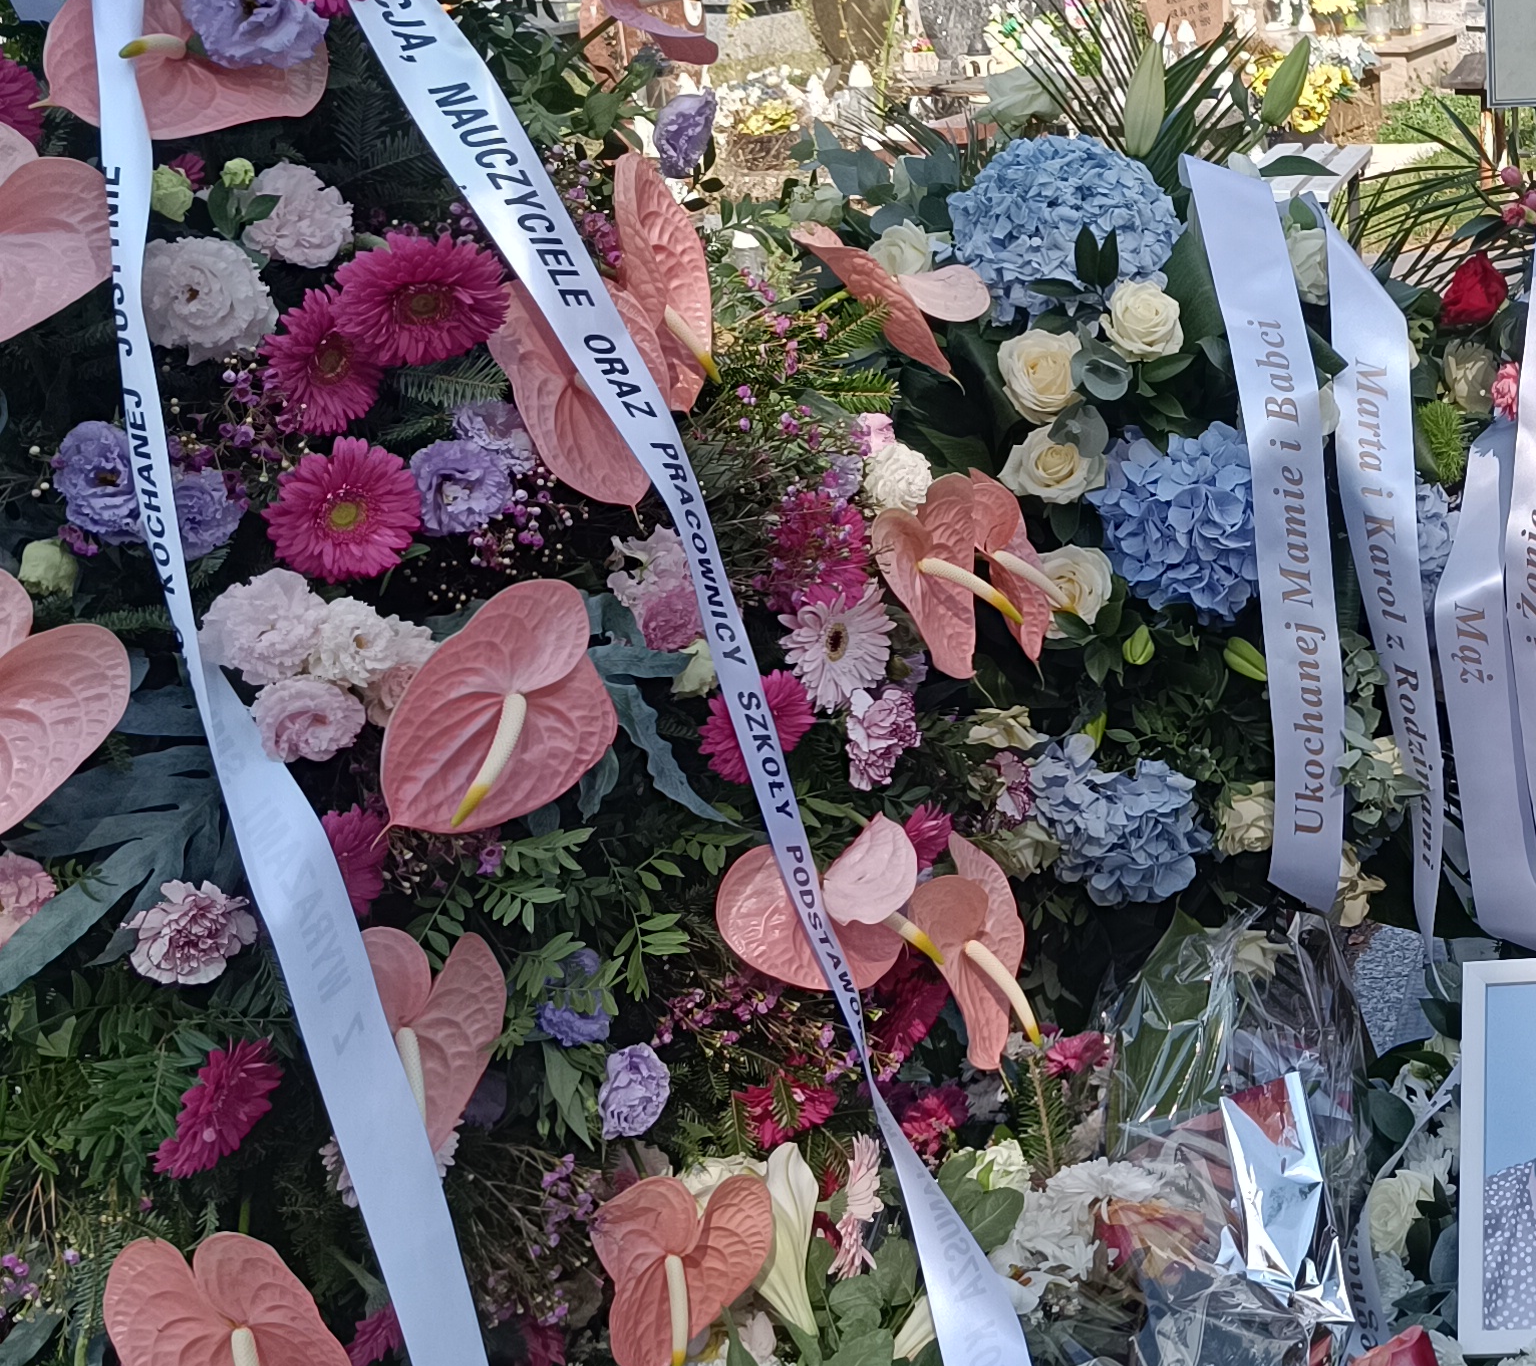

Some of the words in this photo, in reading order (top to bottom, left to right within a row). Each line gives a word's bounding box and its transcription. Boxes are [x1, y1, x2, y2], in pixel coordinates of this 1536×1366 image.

[1246, 319, 1300, 425] Babci
[1354, 356, 1390, 473] Marta
[124, 388, 176, 595] KOCHANEJ
[427, 81, 596, 309] NAUCZYCIELE
[584, 334, 657, 420] ORAZ
[650, 442, 747, 666] PRACOWNICY
[737, 691, 793, 820] SZKOŁY
[1269, 437, 1303, 452] i
[1360, 486, 1394, 498] i
[1273, 465, 1313, 609] Mamie
[1363, 511, 1408, 633] Karol
[1385, 633, 1406, 651] z
[1451, 601, 1494, 684] Mąż
[1284, 621, 1327, 836] Ukochanej
[1393, 662, 1437, 872] Rodzinami
